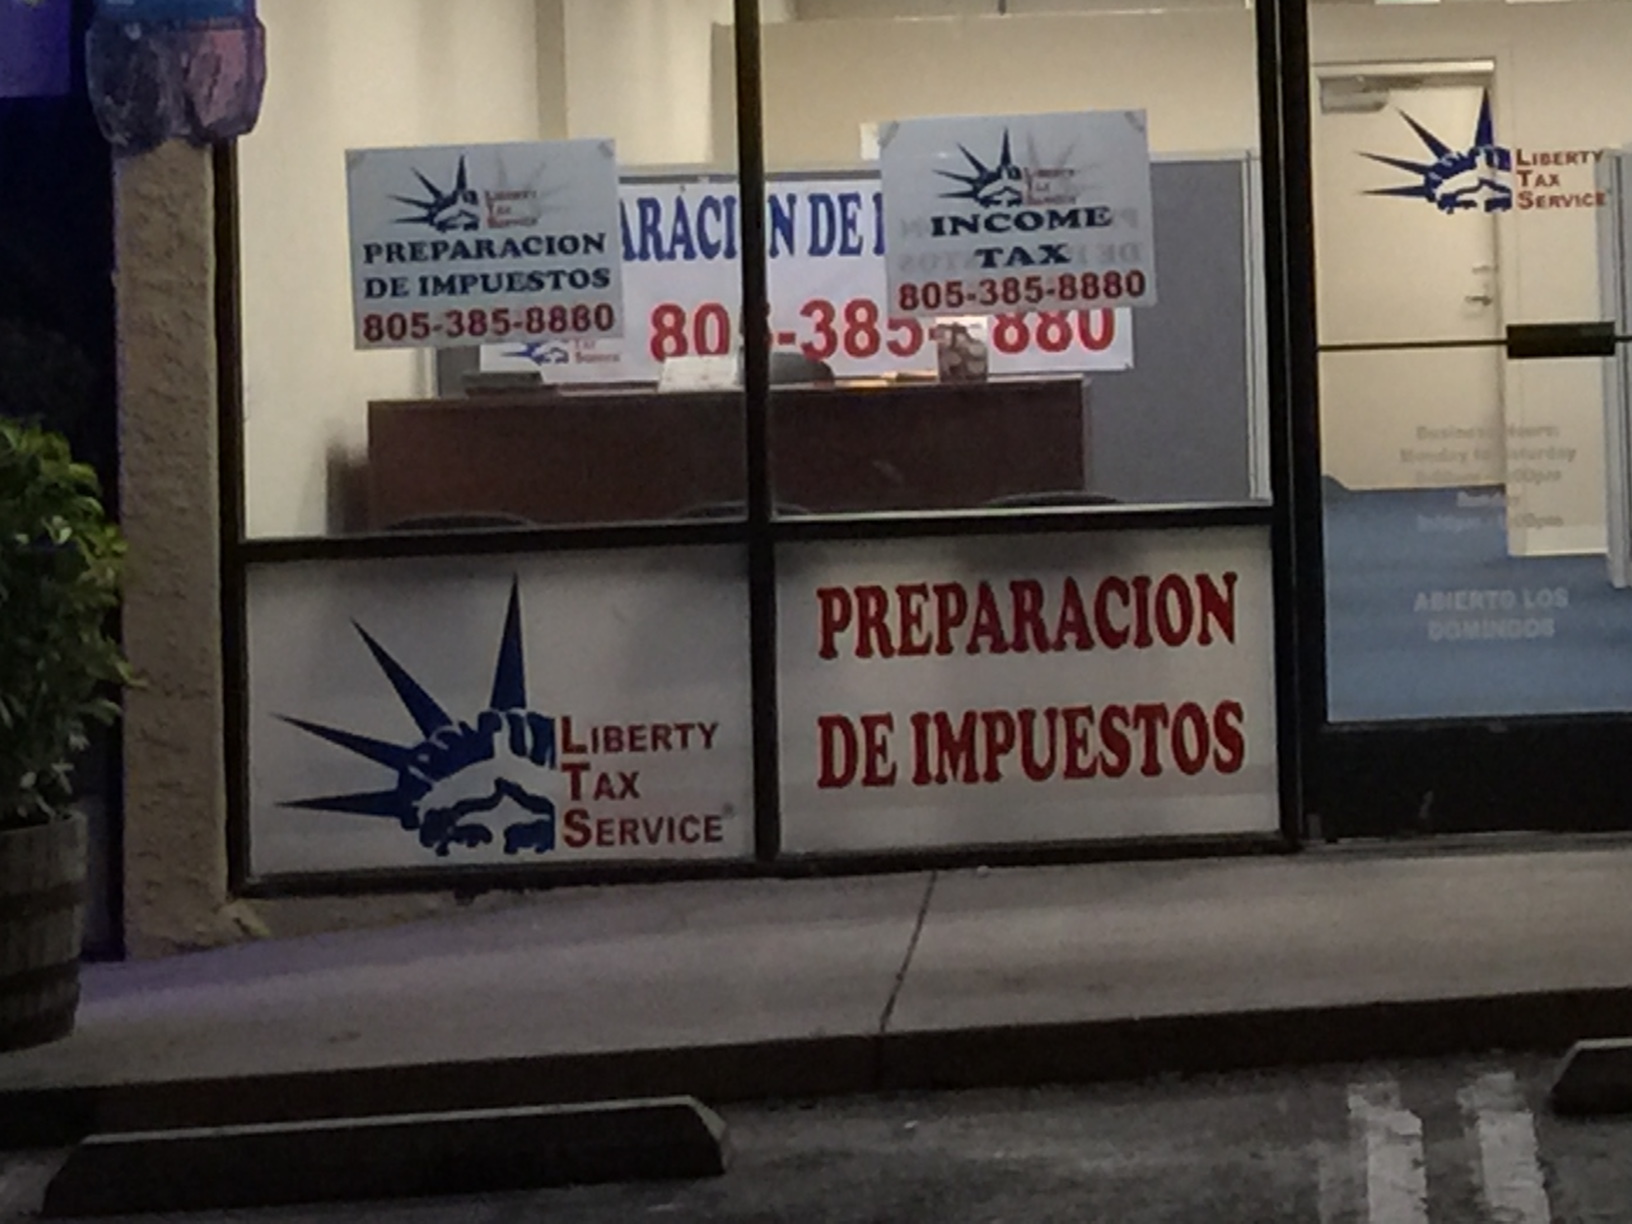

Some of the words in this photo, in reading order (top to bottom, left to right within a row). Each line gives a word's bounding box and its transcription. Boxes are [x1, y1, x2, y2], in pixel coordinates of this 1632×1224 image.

[1516, 148, 1604, 166] LIBERTY
[1516, 169, 1560, 187] TAX
[1517, 190, 1606, 210] SERVICE
[808, 192, 864, 257] DE
[931, 205, 1113, 238] INCOME
[363, 232, 606, 264] PREPARACION
[975, 242, 1071, 269] TAX
[364, 277, 408, 300] DE
[418, 267, 611, 297] IMPUESTOS
[899, 269, 1146, 311] 805-385-8880
[363, 302, 614, 343] 805-385-8880
[816, 572, 1238, 660] PREPARACION
[1414, 589, 1517, 612] ABIERTO
[1522, 586, 1569, 609] LOS
[560, 715, 719, 755] LIBERTY
[816, 713, 896, 789] DE
[909, 700, 1245, 786] IMPUESTOS
[560, 761, 641, 802] TAX
[562, 807, 724, 848] SERVICE
